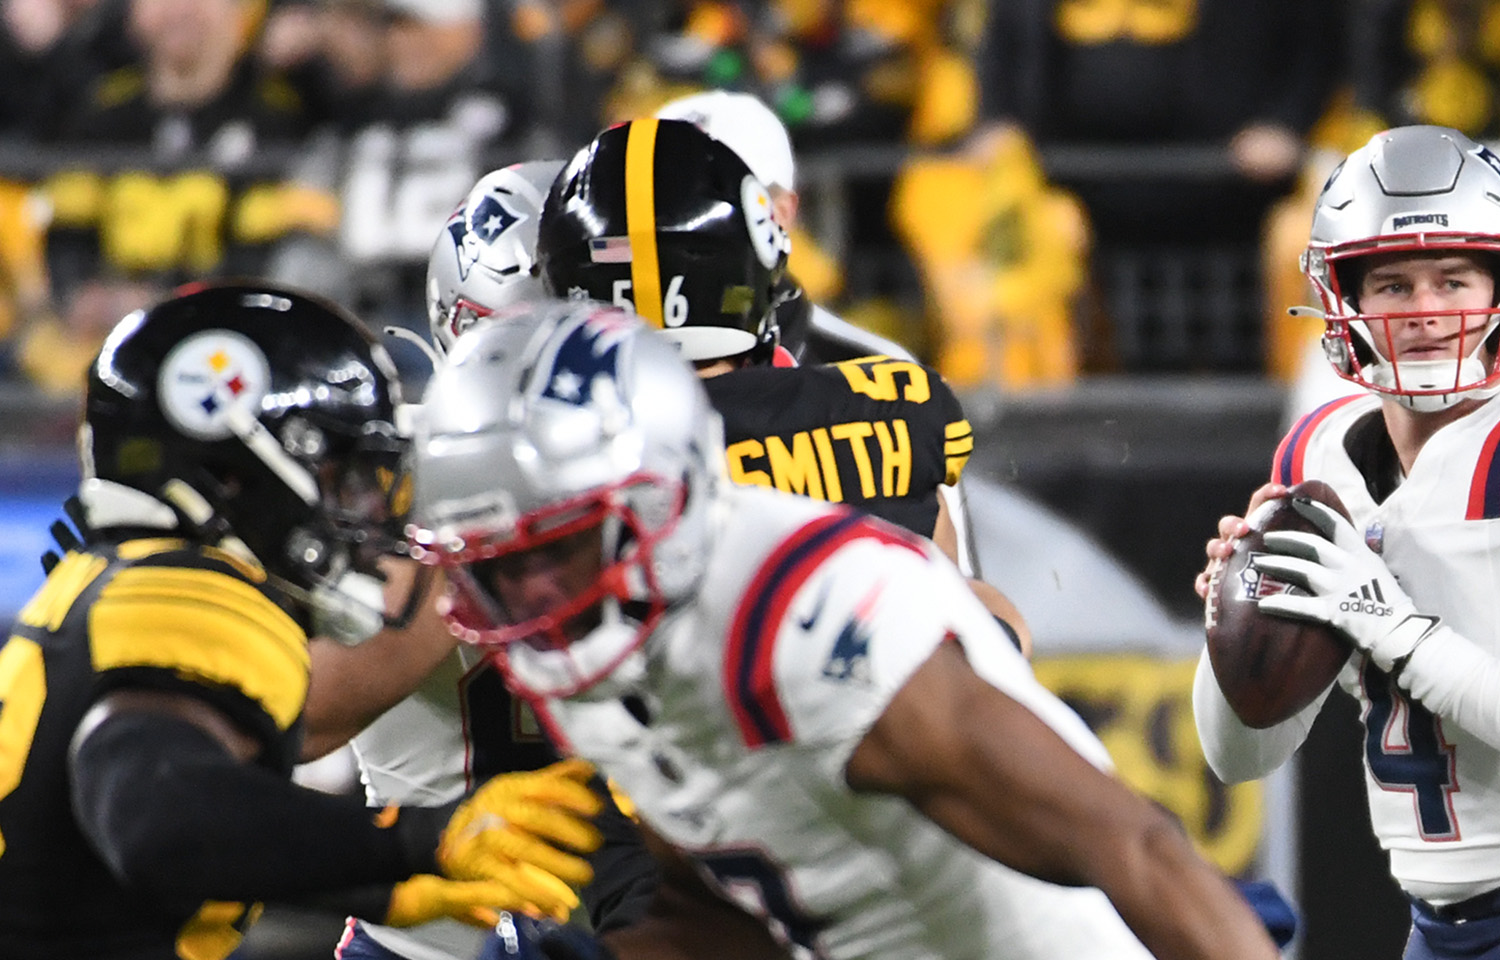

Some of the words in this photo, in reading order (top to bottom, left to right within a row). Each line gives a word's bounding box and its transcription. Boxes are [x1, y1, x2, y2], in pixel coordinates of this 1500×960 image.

[1393, 213, 1449, 231] PATRIOTS
[612, 274, 689, 328] 56
[726, 418, 912, 503] SMITH
[1339, 600, 1394, 617] adidas
[1360, 648, 1462, 843] 4
